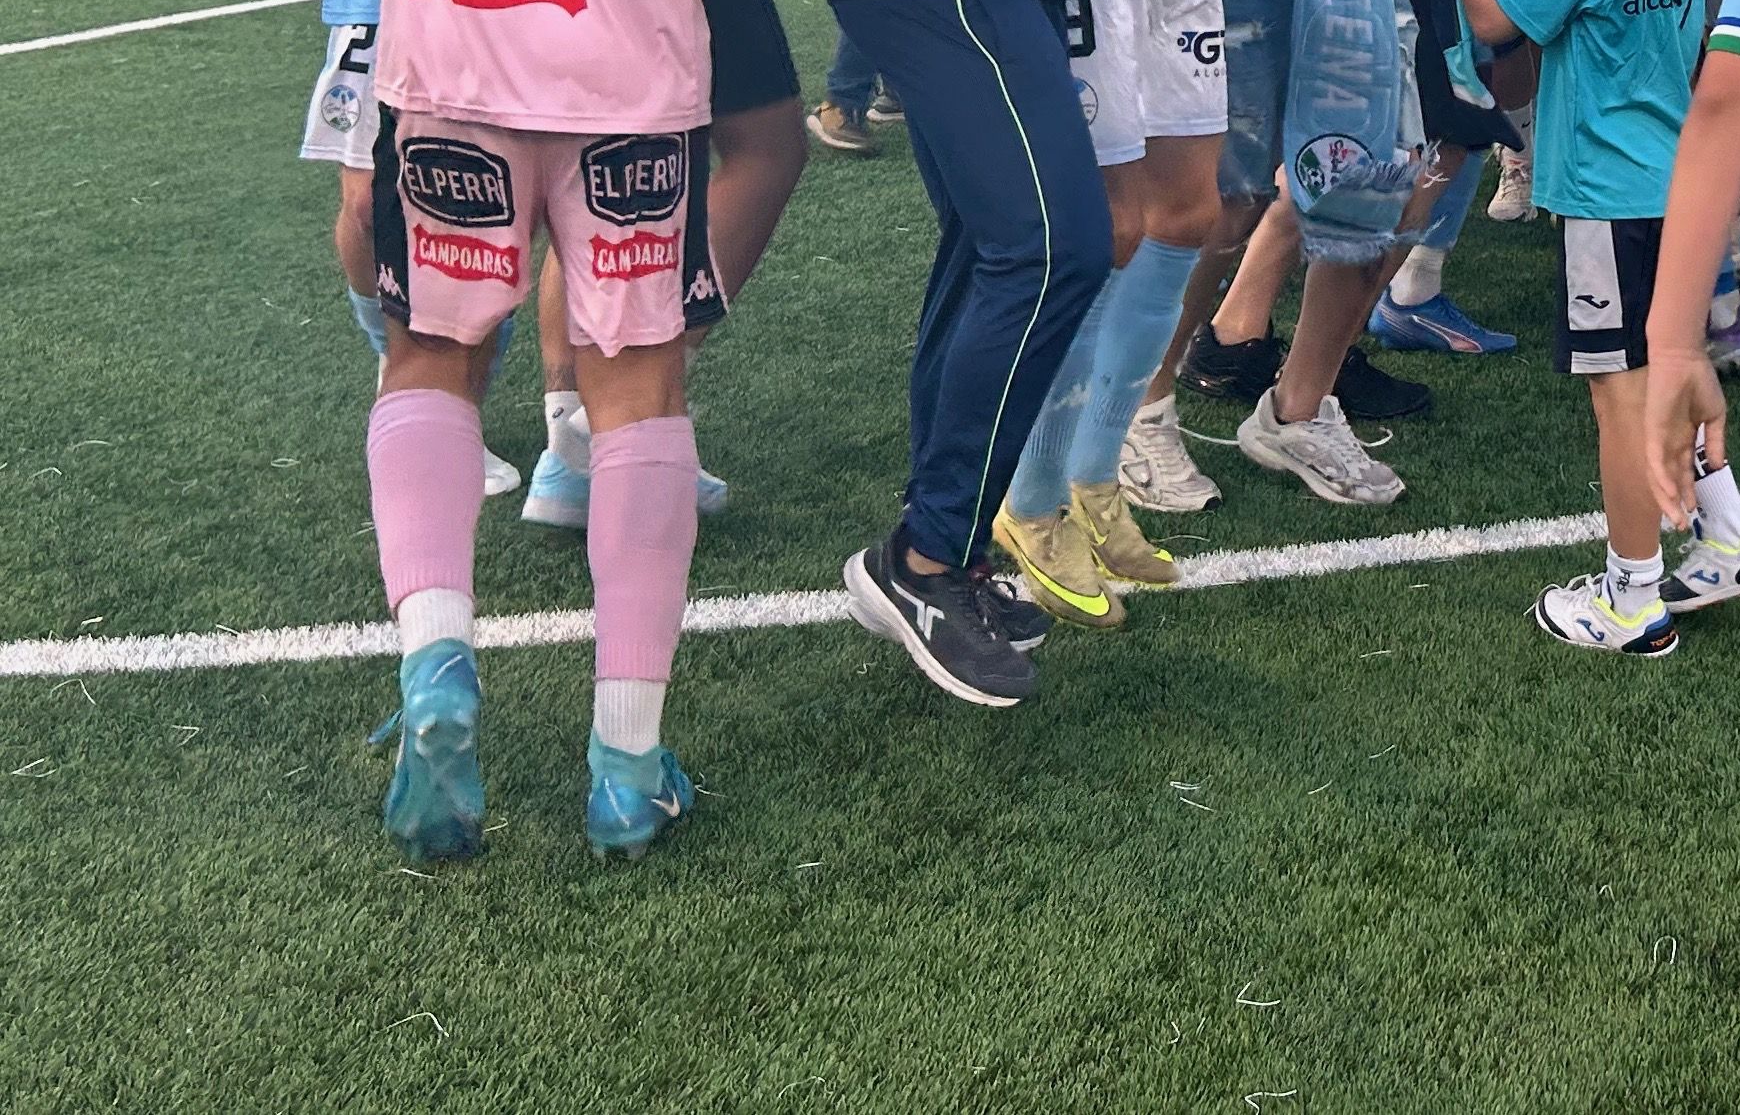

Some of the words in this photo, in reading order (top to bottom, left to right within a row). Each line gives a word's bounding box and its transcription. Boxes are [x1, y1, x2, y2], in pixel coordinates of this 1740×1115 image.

[339, 23, 378, 75] 2
[404, 162, 433, 195] EL
[589, 164, 620, 198] EL
[418, 237, 514, 278] CAMPOARAS
